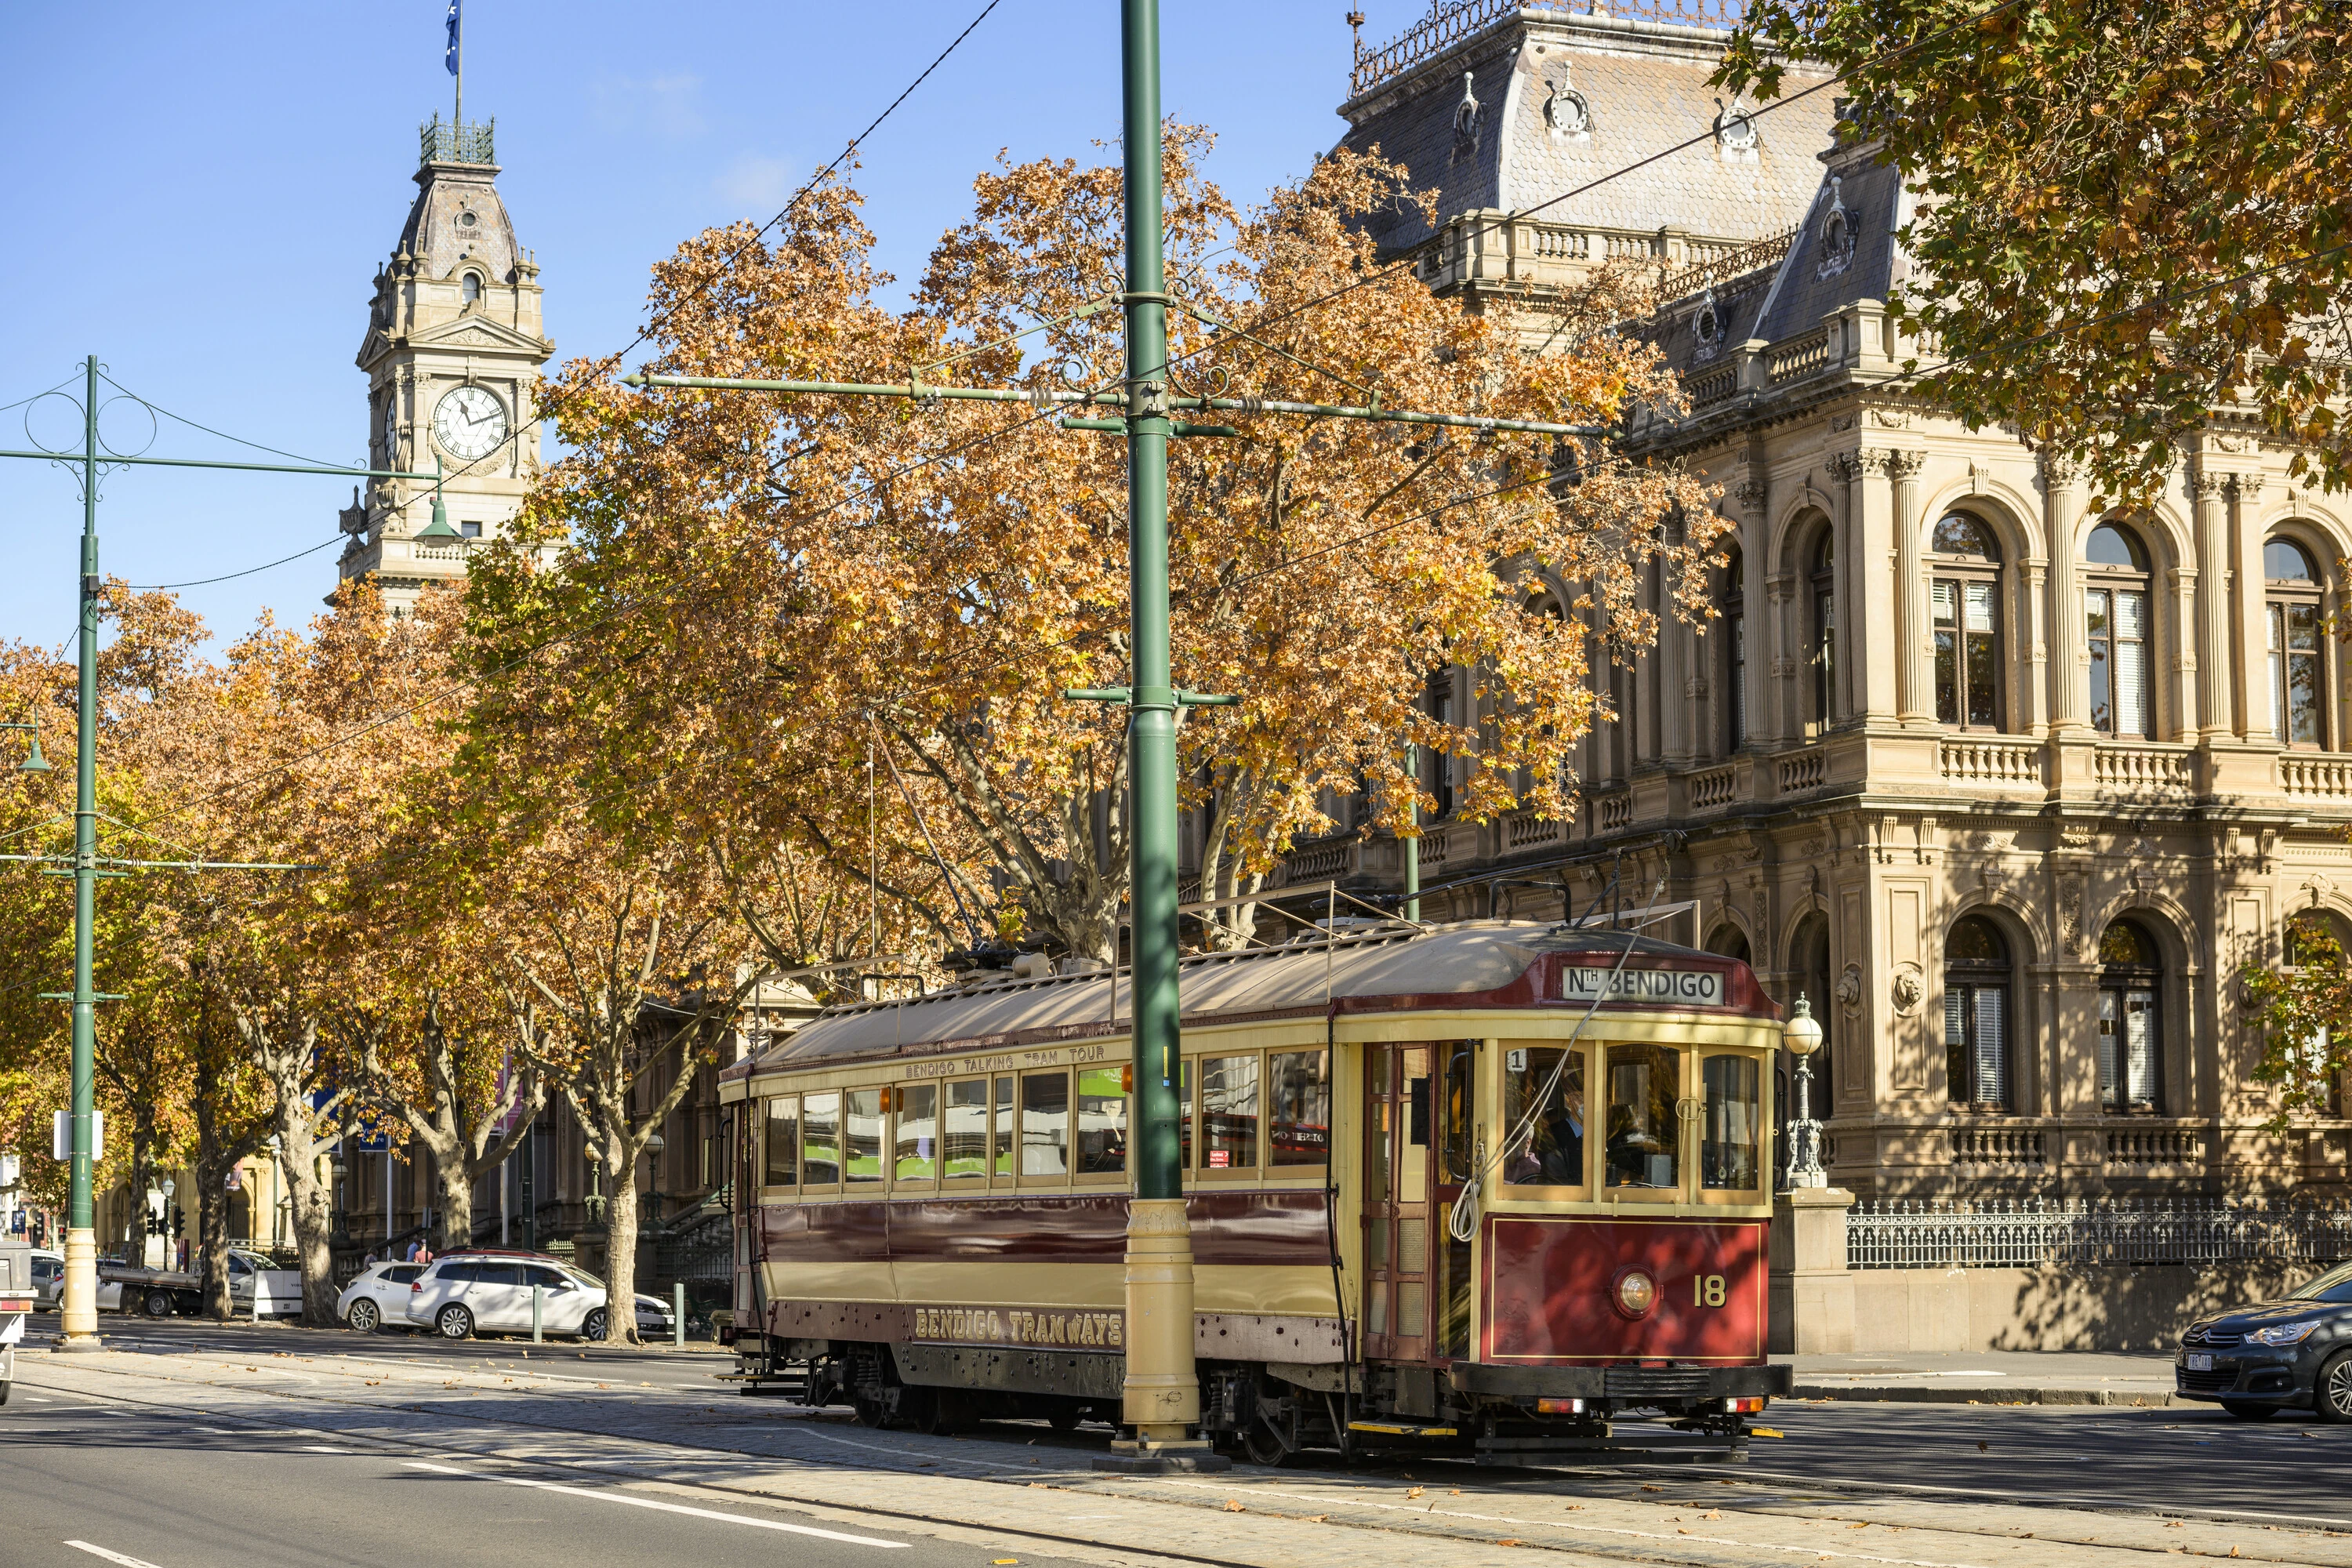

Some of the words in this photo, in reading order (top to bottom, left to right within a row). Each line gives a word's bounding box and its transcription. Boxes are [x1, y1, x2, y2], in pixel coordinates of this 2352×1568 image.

[1608, 970, 1715, 998] BENDIGO
[906, 1061, 955, 1078] BENDIGO
[964, 1055, 1014, 1073] TALKING
[1024, 1051, 1058, 1067] TRAM
[1069, 1046, 1104, 1062] TOUR
[1512, 1051, 1523, 1068] 1
[1694, 1275, 1726, 1308] 18
[916, 1308, 1000, 1340] BENDIGO
[1009, 1311, 1123, 1345] TRAMWAYS
